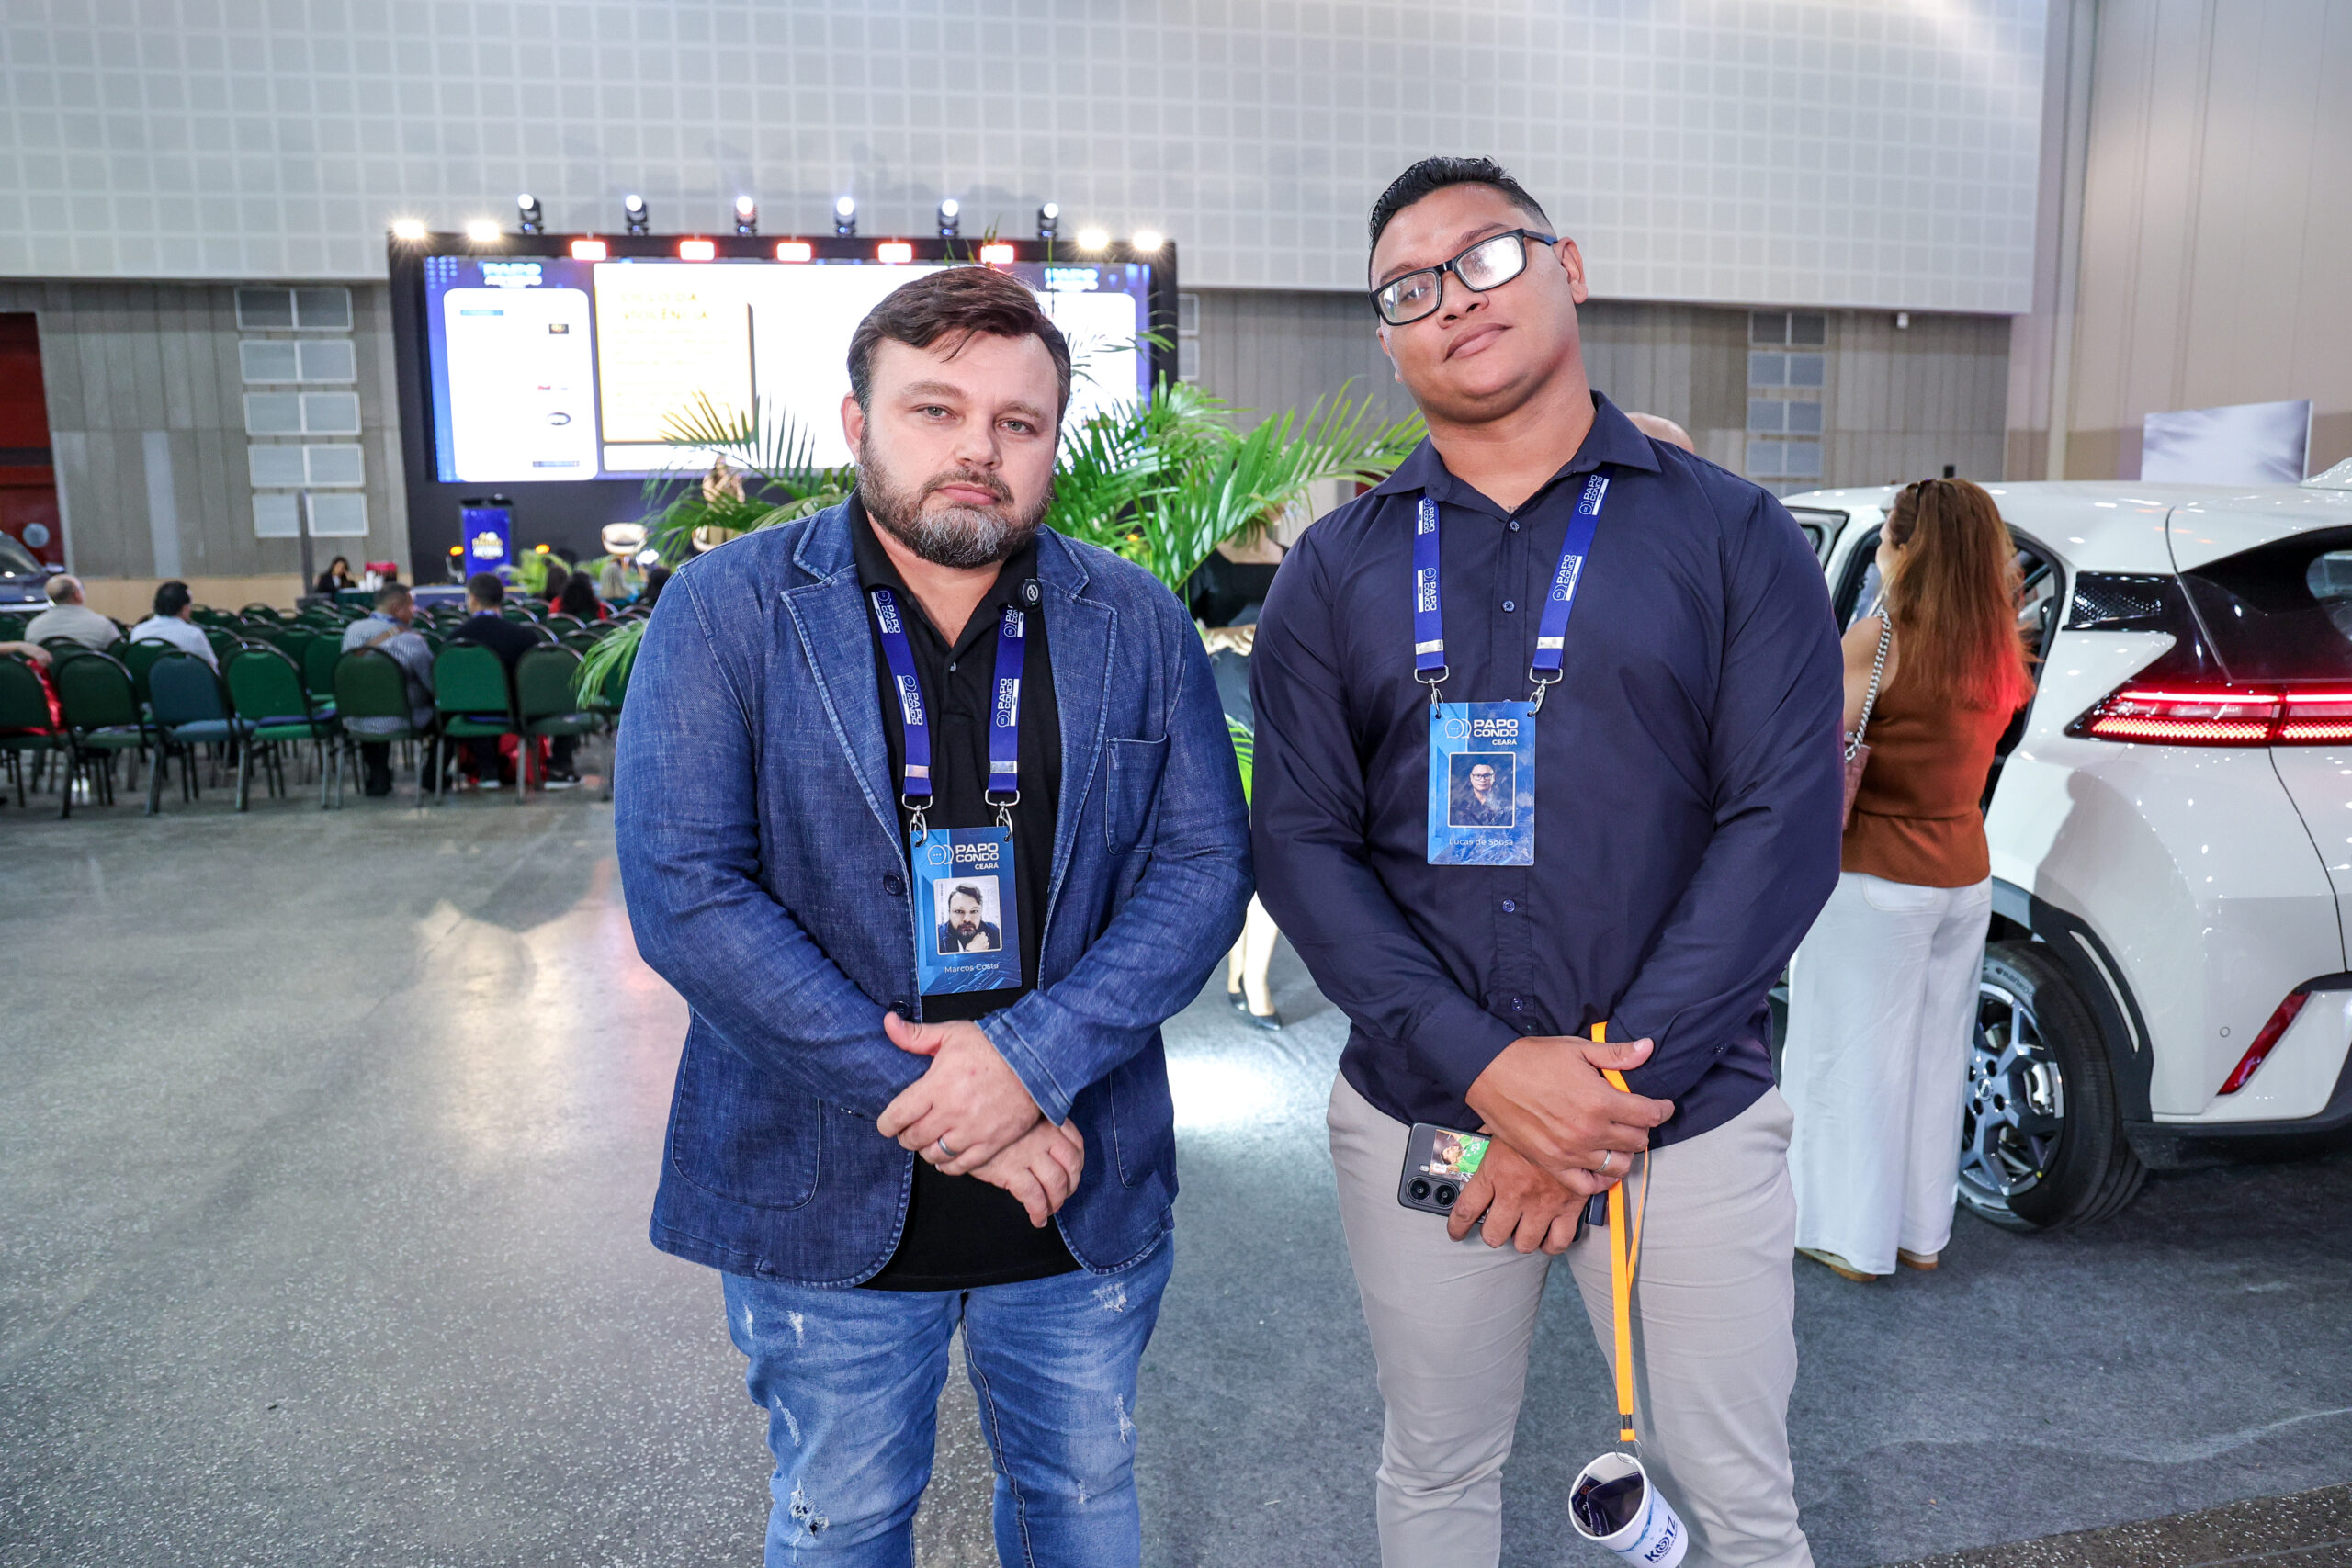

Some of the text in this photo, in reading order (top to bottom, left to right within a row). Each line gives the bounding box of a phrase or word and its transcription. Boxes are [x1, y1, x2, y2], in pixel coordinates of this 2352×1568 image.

[1583, 474, 1598, 500] PAPO
[1589, 476, 1603, 502] CONDO
[1556, 554, 1571, 584] PAPO
[1563, 555, 1577, 585] CONDO
[881, 605, 895, 634] CONDO
[887, 604, 900, 634] PAPO
[997, 678, 1007, 710] PAPO
[1004, 678, 1013, 710] CONDO
[907, 692, 918, 726] CONDO
[911, 692, 923, 726] PAPO
[1473, 719, 1519, 728] PAPO
[1473, 728, 1519, 738] CONDO
[1491, 738, 1518, 746] CEARÁ
[956, 842, 1000, 854] PAPO
[1475, 838, 1487, 846] de
[1487, 838, 1514, 846] Sousa
[956, 852, 1000, 863] CONDO
[974, 862, 1000, 870] CEARÁ
[944, 962, 1000, 974] Marcos Costa
[1644, 1513, 1676, 1562] KOTZ
